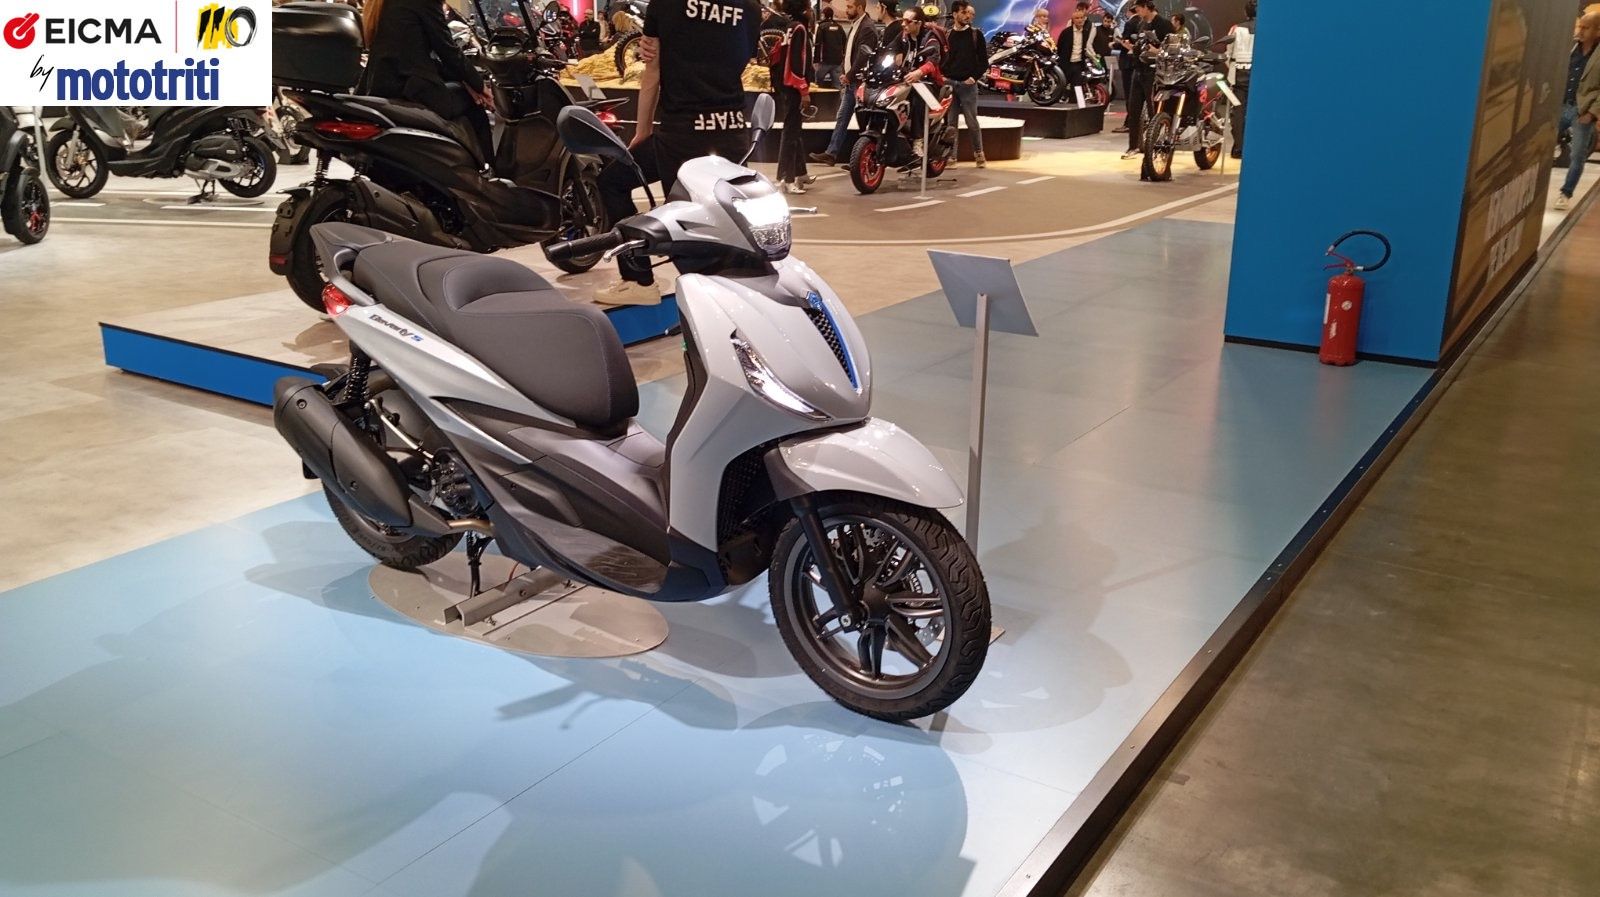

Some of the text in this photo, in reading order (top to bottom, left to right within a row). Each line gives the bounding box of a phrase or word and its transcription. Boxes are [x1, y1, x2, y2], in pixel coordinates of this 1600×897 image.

[686, 0, 743, 26] STAFF
[694, 110, 744, 130] STAFF
[369, 314, 424, 342] Beverly S
